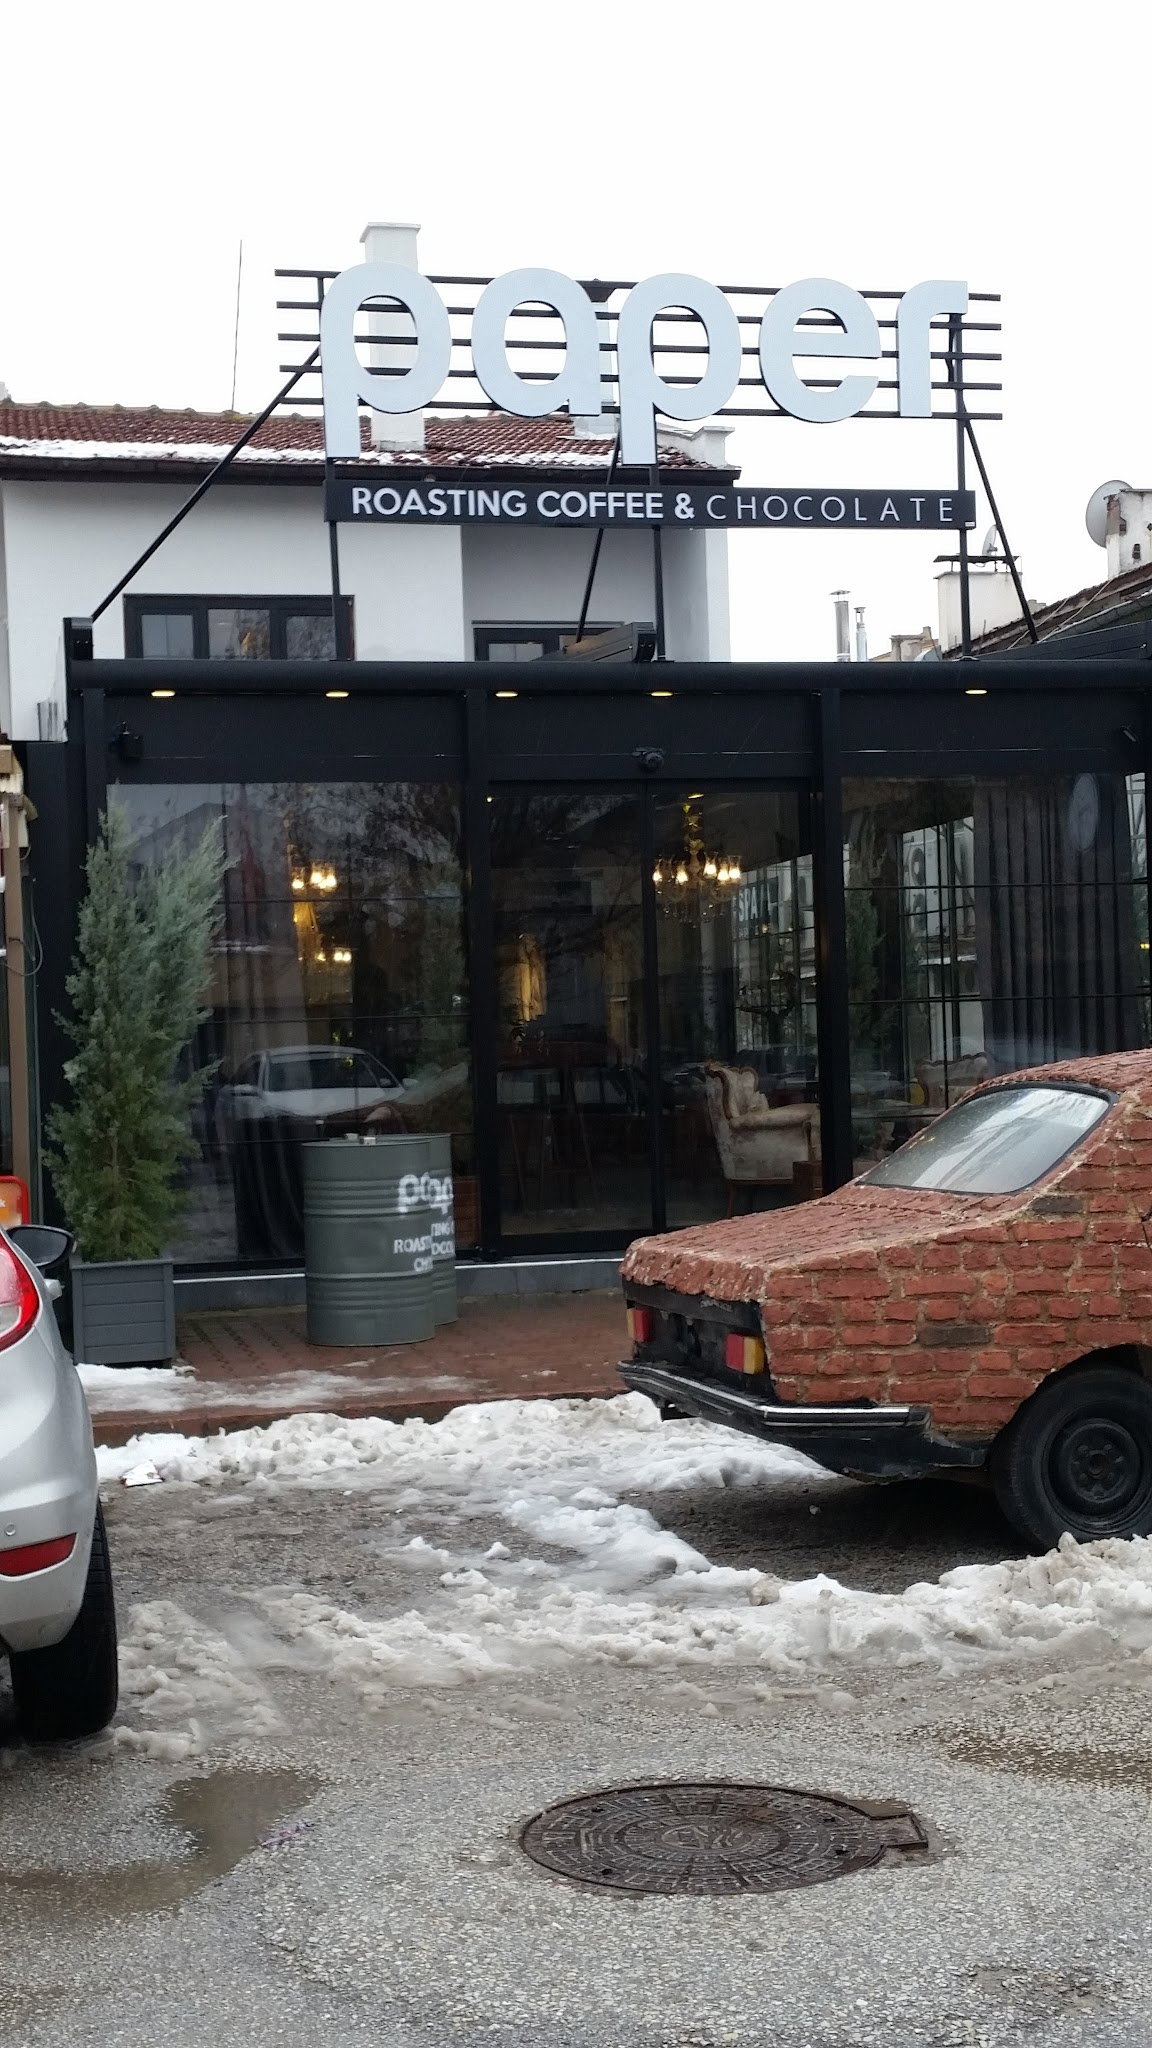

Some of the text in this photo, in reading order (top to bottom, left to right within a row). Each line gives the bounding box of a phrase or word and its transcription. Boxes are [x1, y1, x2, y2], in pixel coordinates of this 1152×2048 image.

[319, 261, 968, 465] paper
[352, 486, 953, 522] ROASTING COFFEE & CHOCOLATE
